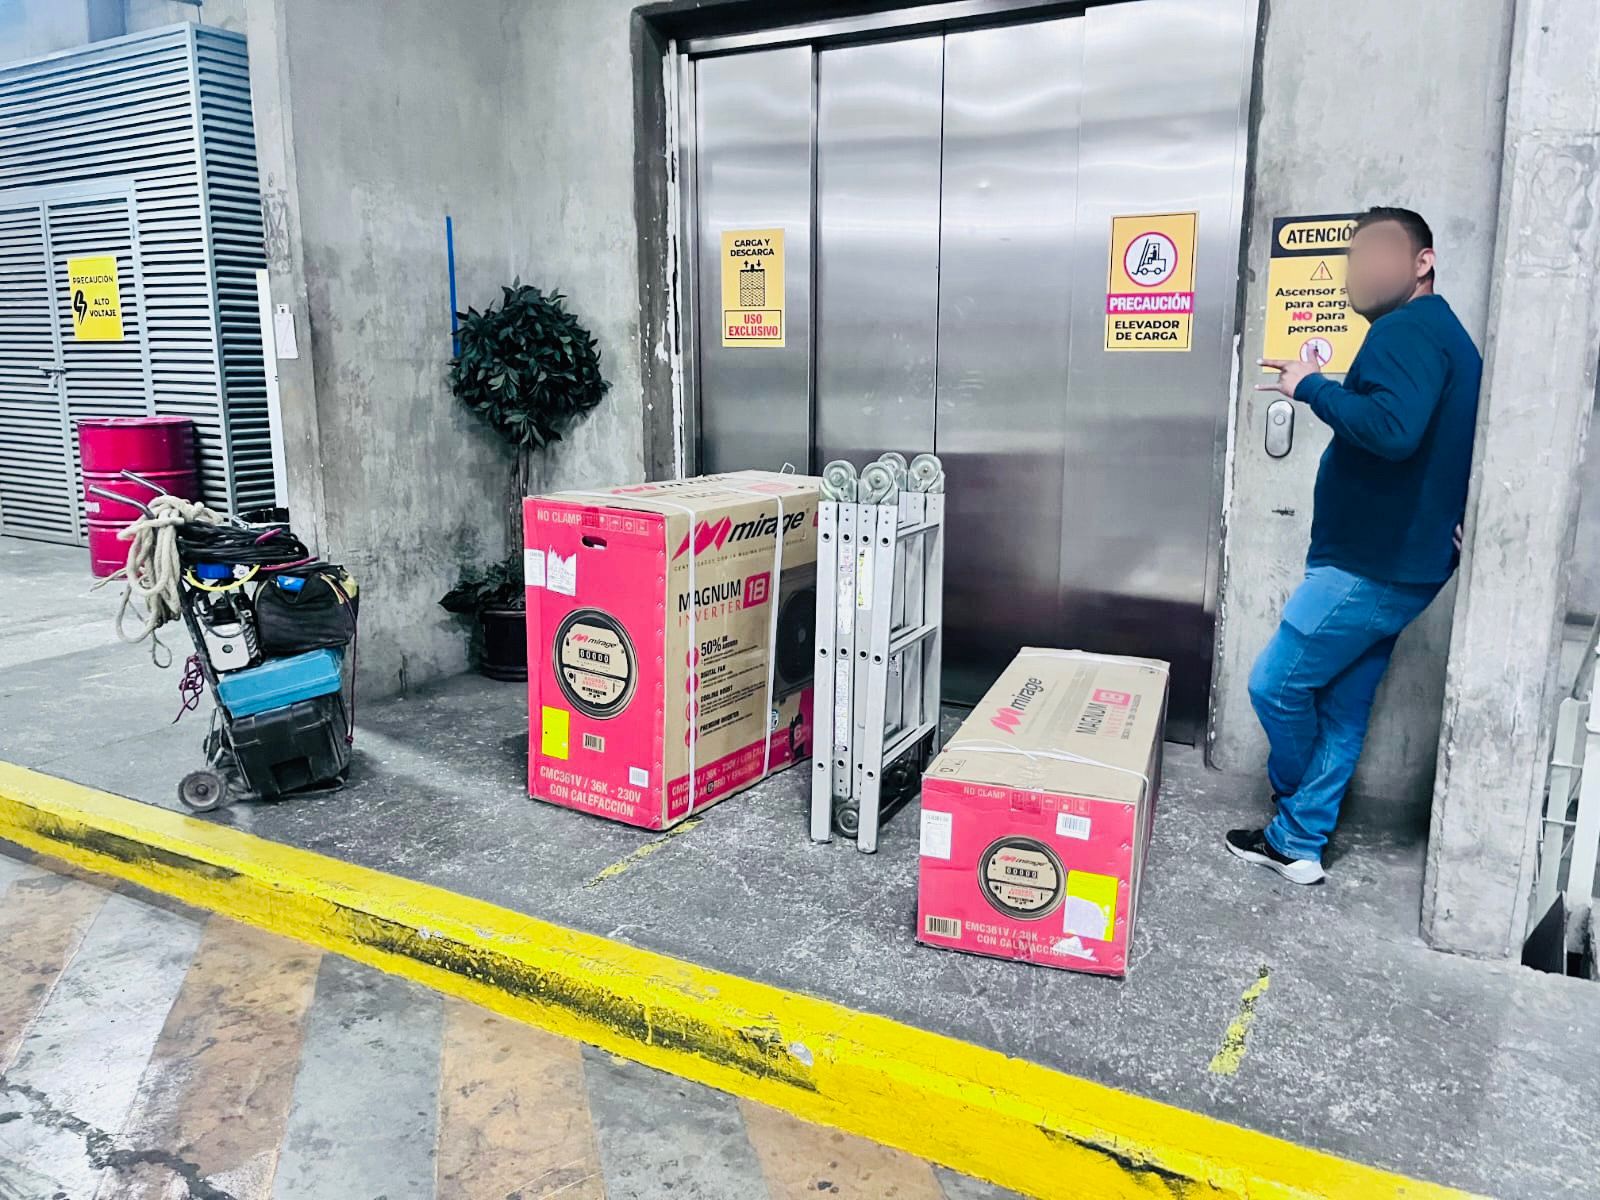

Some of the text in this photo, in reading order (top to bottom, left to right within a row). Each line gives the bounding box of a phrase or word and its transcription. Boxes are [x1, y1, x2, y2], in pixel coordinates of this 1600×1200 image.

[1286, 223, 1353, 244] ATENCIÓ
[734, 238, 771, 247] CARGA Y
[730, 248, 775, 257] DESCARGA
[1275, 287, 1337, 297] Ascensor
[93, 298, 110, 306] ALTO
[1109, 293, 1191, 311] PRECAUCIÓN
[1285, 300, 1314, 311] para
[89, 309, 117, 317] VOLTAJE
[1292, 311, 1345, 322] NO para
[743, 314, 763, 324] USO
[1114, 320, 1180, 329] ELEVADOR
[728, 325, 779, 337] EXCLUSIVO
[1115, 331, 1178, 340] DE CARGA
[1287, 325, 1349, 335] personas
[537, 509, 582, 526] NO CLAMP
[727, 511, 806, 543] mirage
[678, 578, 767, 613] MAGNUM 18
[678, 601, 742, 628] INVERTER
[587, 638, 617, 649] mirage
[701, 636, 722, 657] 50%
[1010, 677, 1044, 711] mirage
[1075, 702, 1108, 736] MAGNUM
[539, 765, 582, 787] CMC361V
[590, 779, 608, 795] 36K
[617, 786, 642, 803] 230V
[963, 785, 1006, 799] NO CLAMP
[549, 783, 634, 817] CON CALEFACCIÓN
[977, 934, 997, 945] CON
